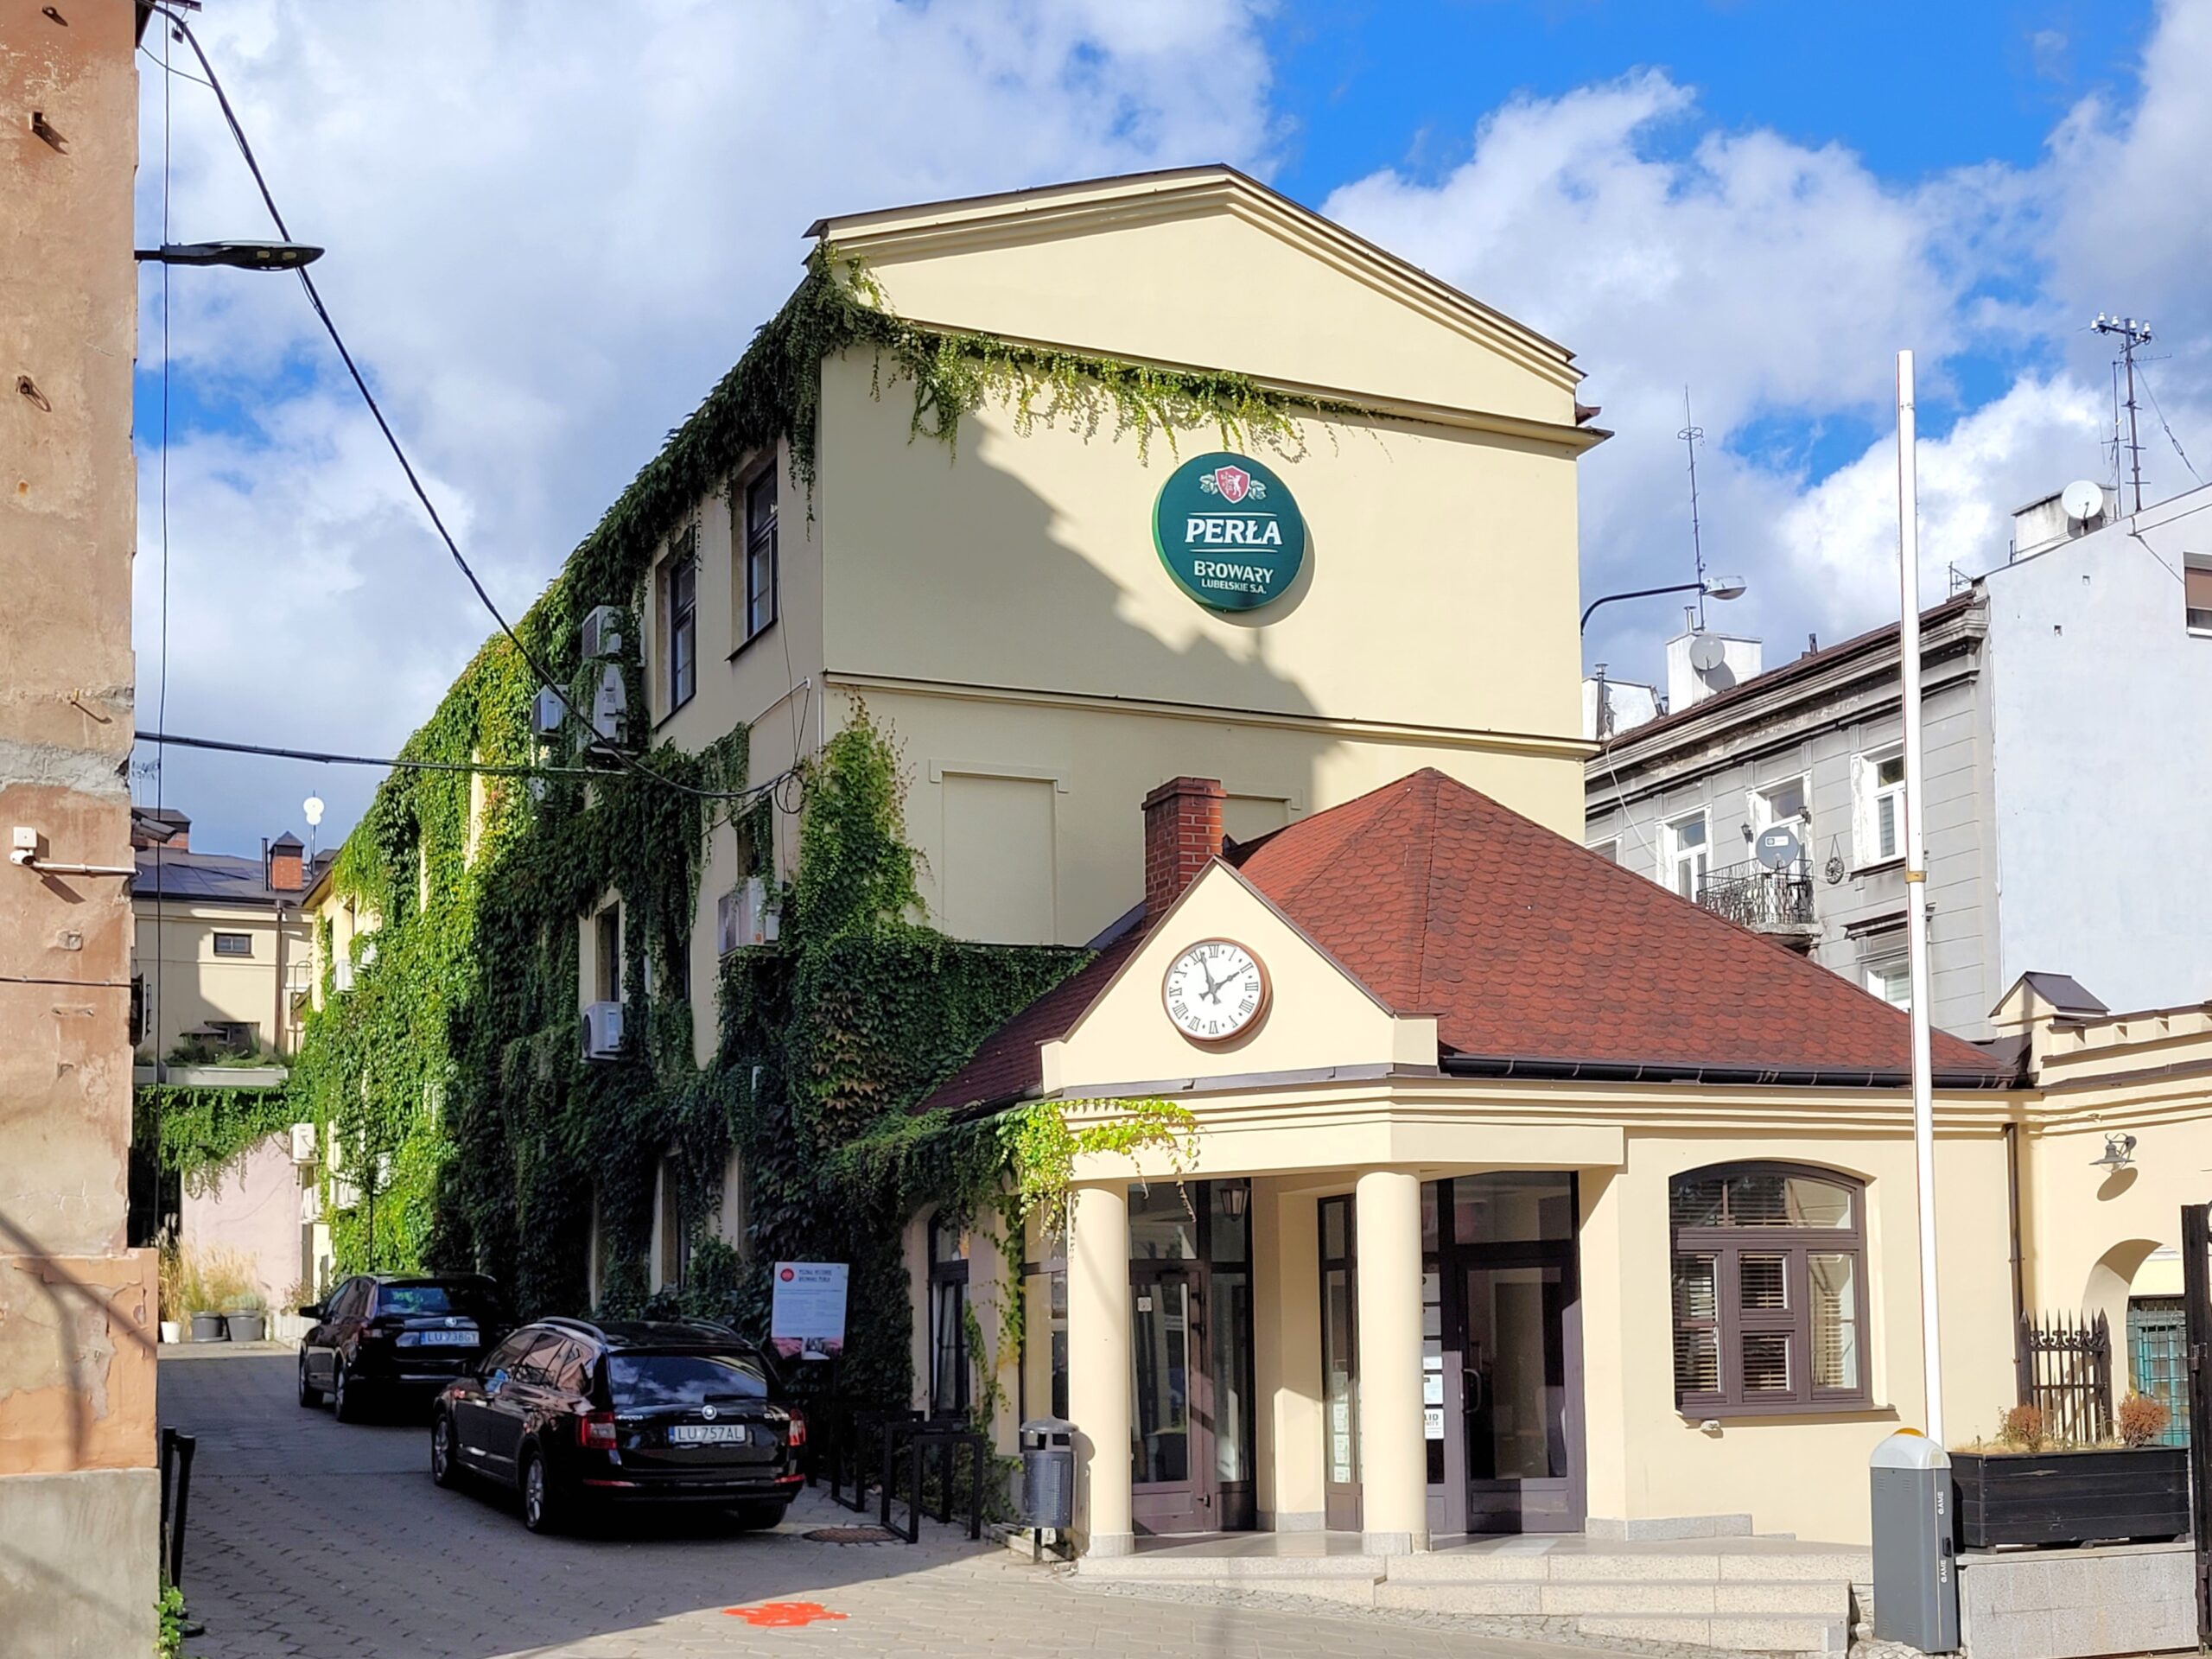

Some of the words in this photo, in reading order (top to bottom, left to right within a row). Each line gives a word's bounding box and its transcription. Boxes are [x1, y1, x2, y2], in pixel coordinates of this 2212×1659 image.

[1185, 518, 1282, 545] PERŁA
[1194, 560, 1274, 584] BROWARY
[1201, 578, 1249, 592] LUBELSKIE
[1249, 585, 1267, 594] S.A.
[428, 1332, 442, 1342] LU
[678, 1427, 697, 1440] LU
[701, 1427, 743, 1440] 757AL
